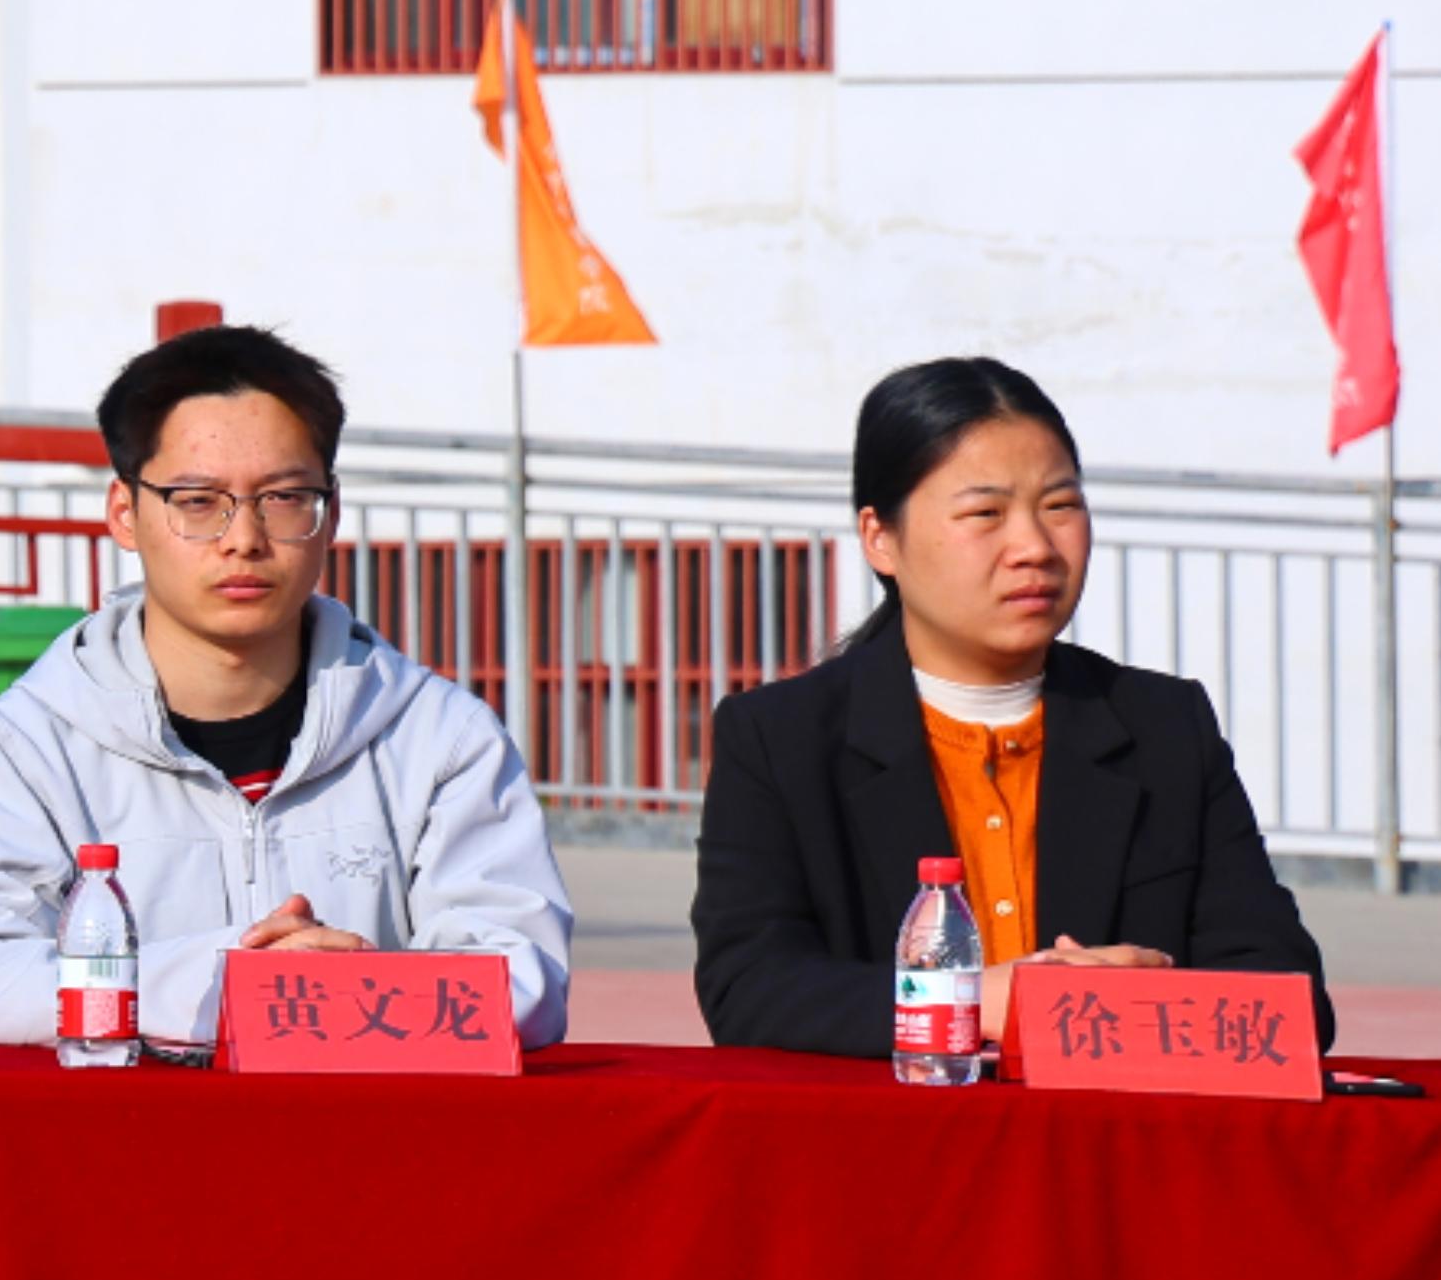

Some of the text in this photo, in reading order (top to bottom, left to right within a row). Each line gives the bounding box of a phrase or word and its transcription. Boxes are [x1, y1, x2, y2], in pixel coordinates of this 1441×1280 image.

[254, 974, 490, 1041] 黄文龙
[1048, 990, 1290, 1066] 徐玉敏
